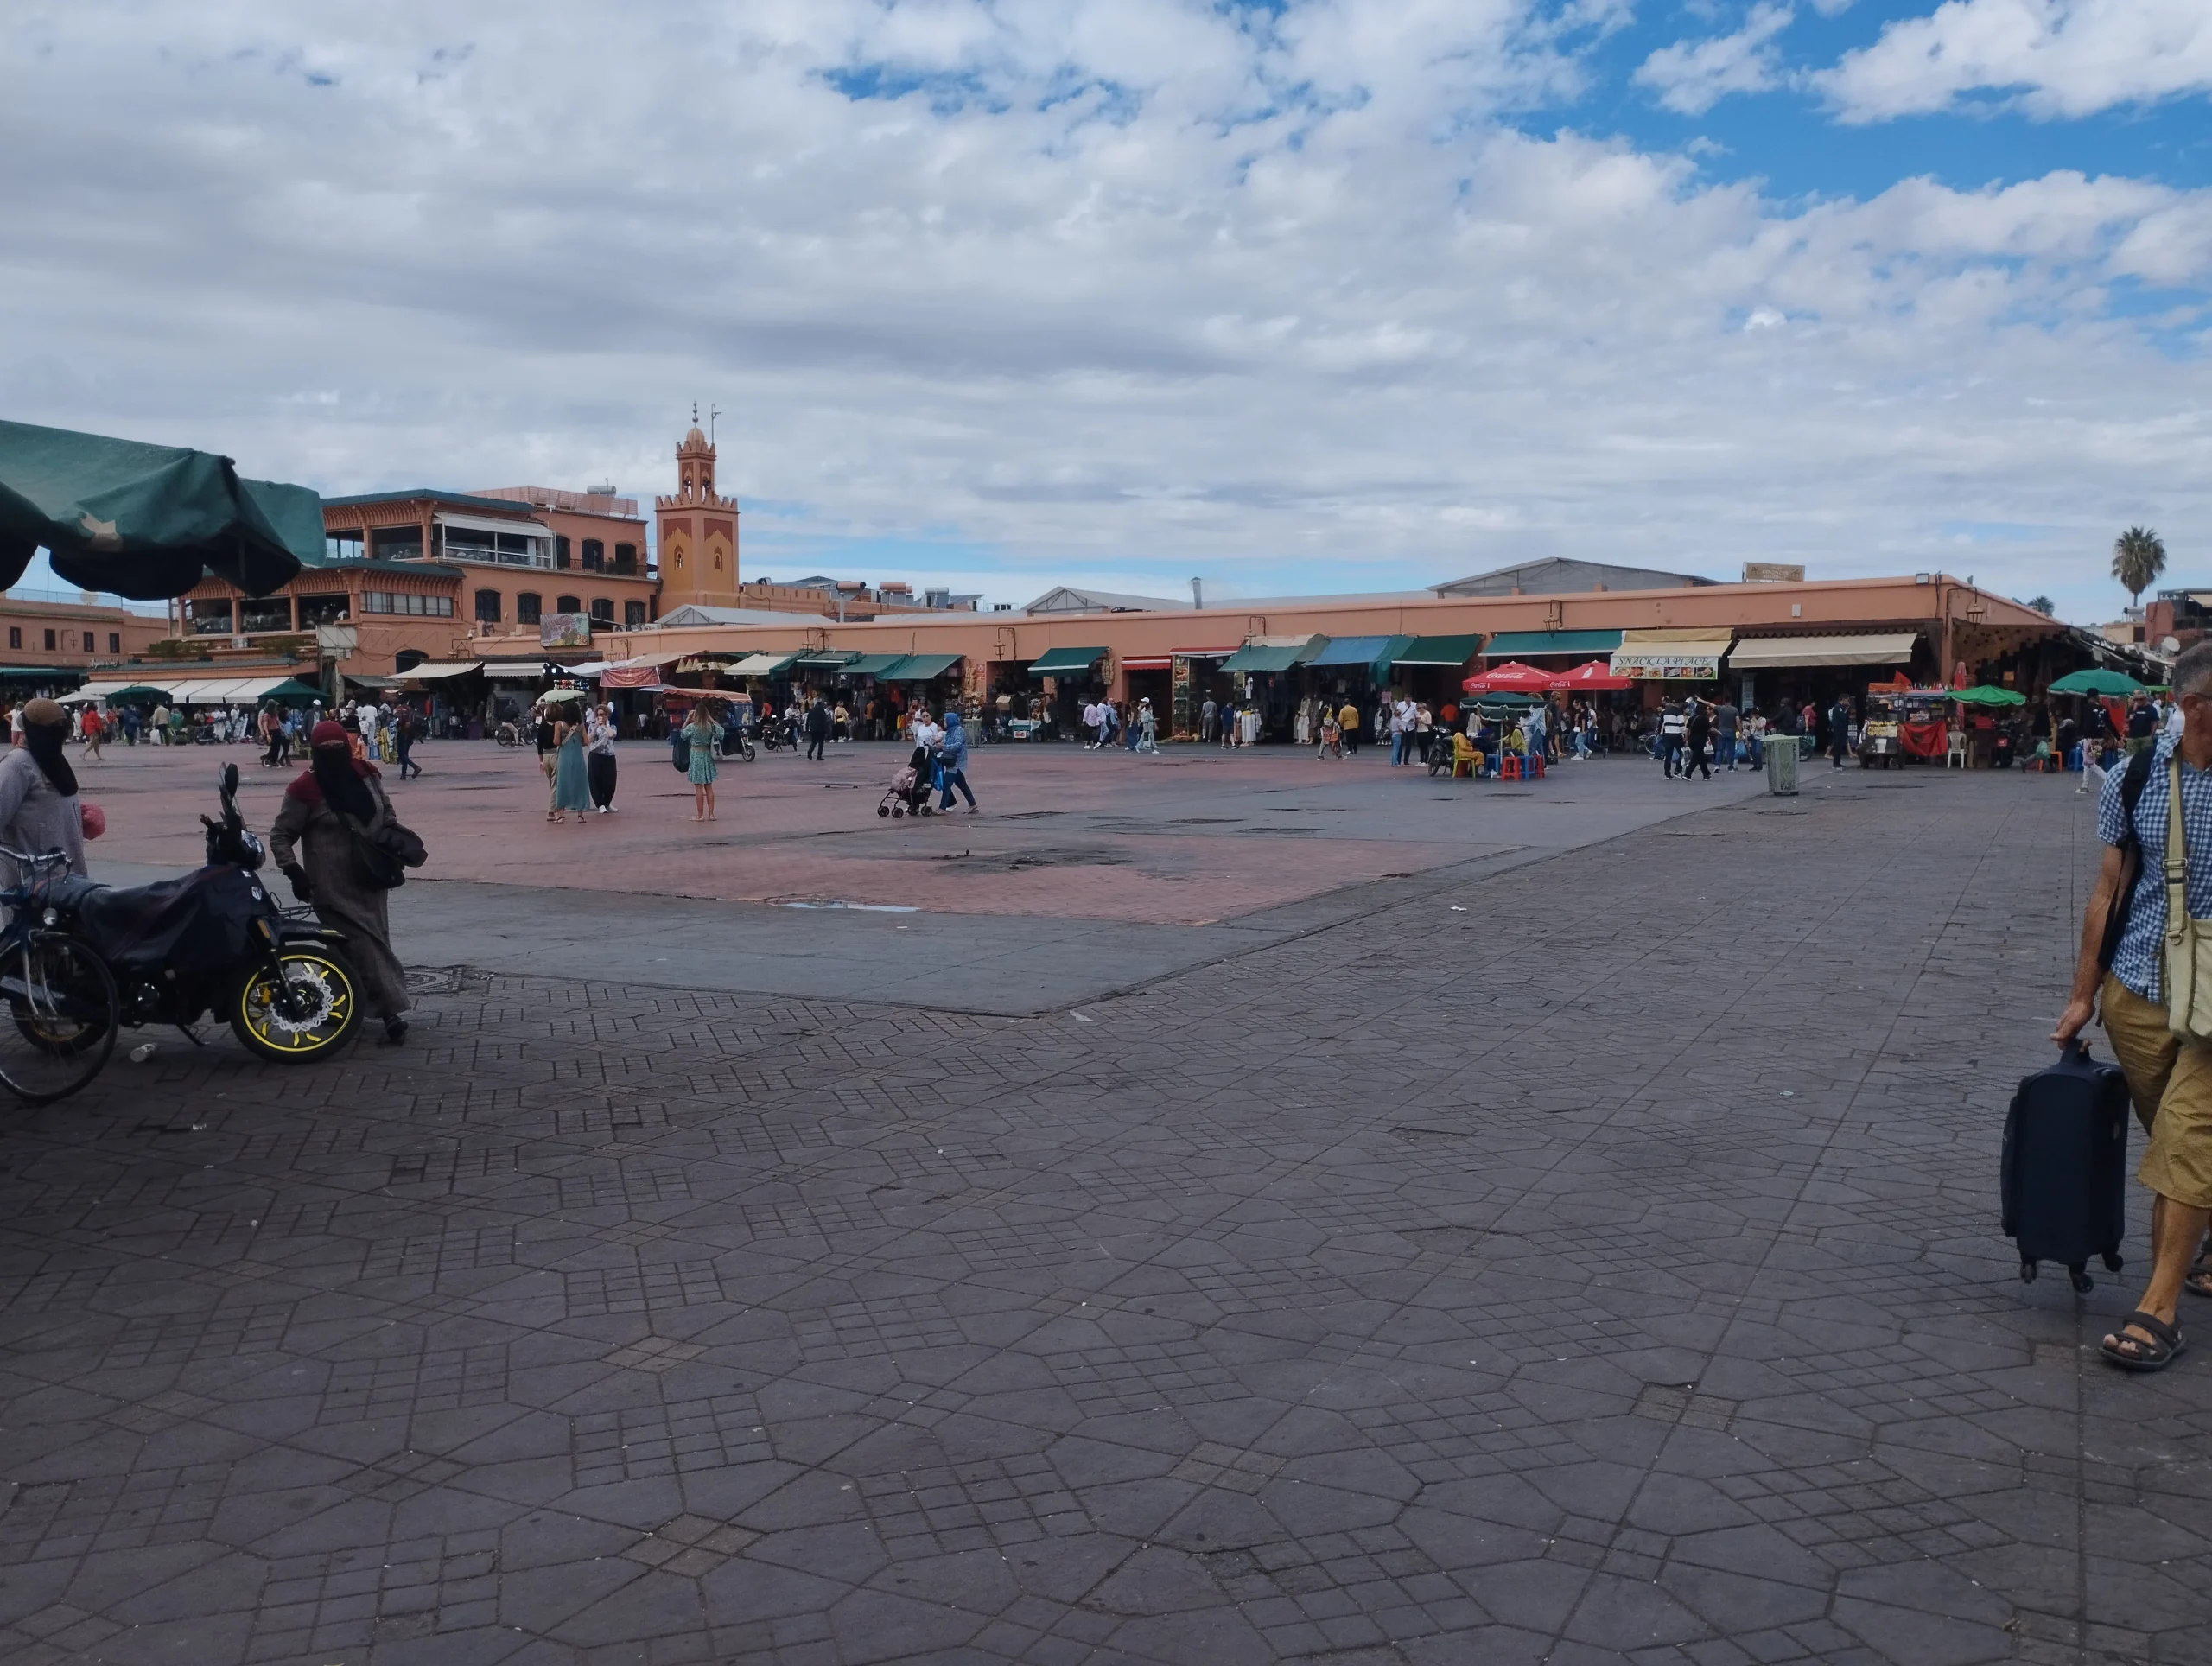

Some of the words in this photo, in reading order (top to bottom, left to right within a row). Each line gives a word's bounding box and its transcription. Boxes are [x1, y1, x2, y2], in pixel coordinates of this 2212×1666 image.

[1618, 657, 1654, 665] SNACK
[1656, 657, 1669, 665] LA
[1673, 657, 1709, 665] PLACE
